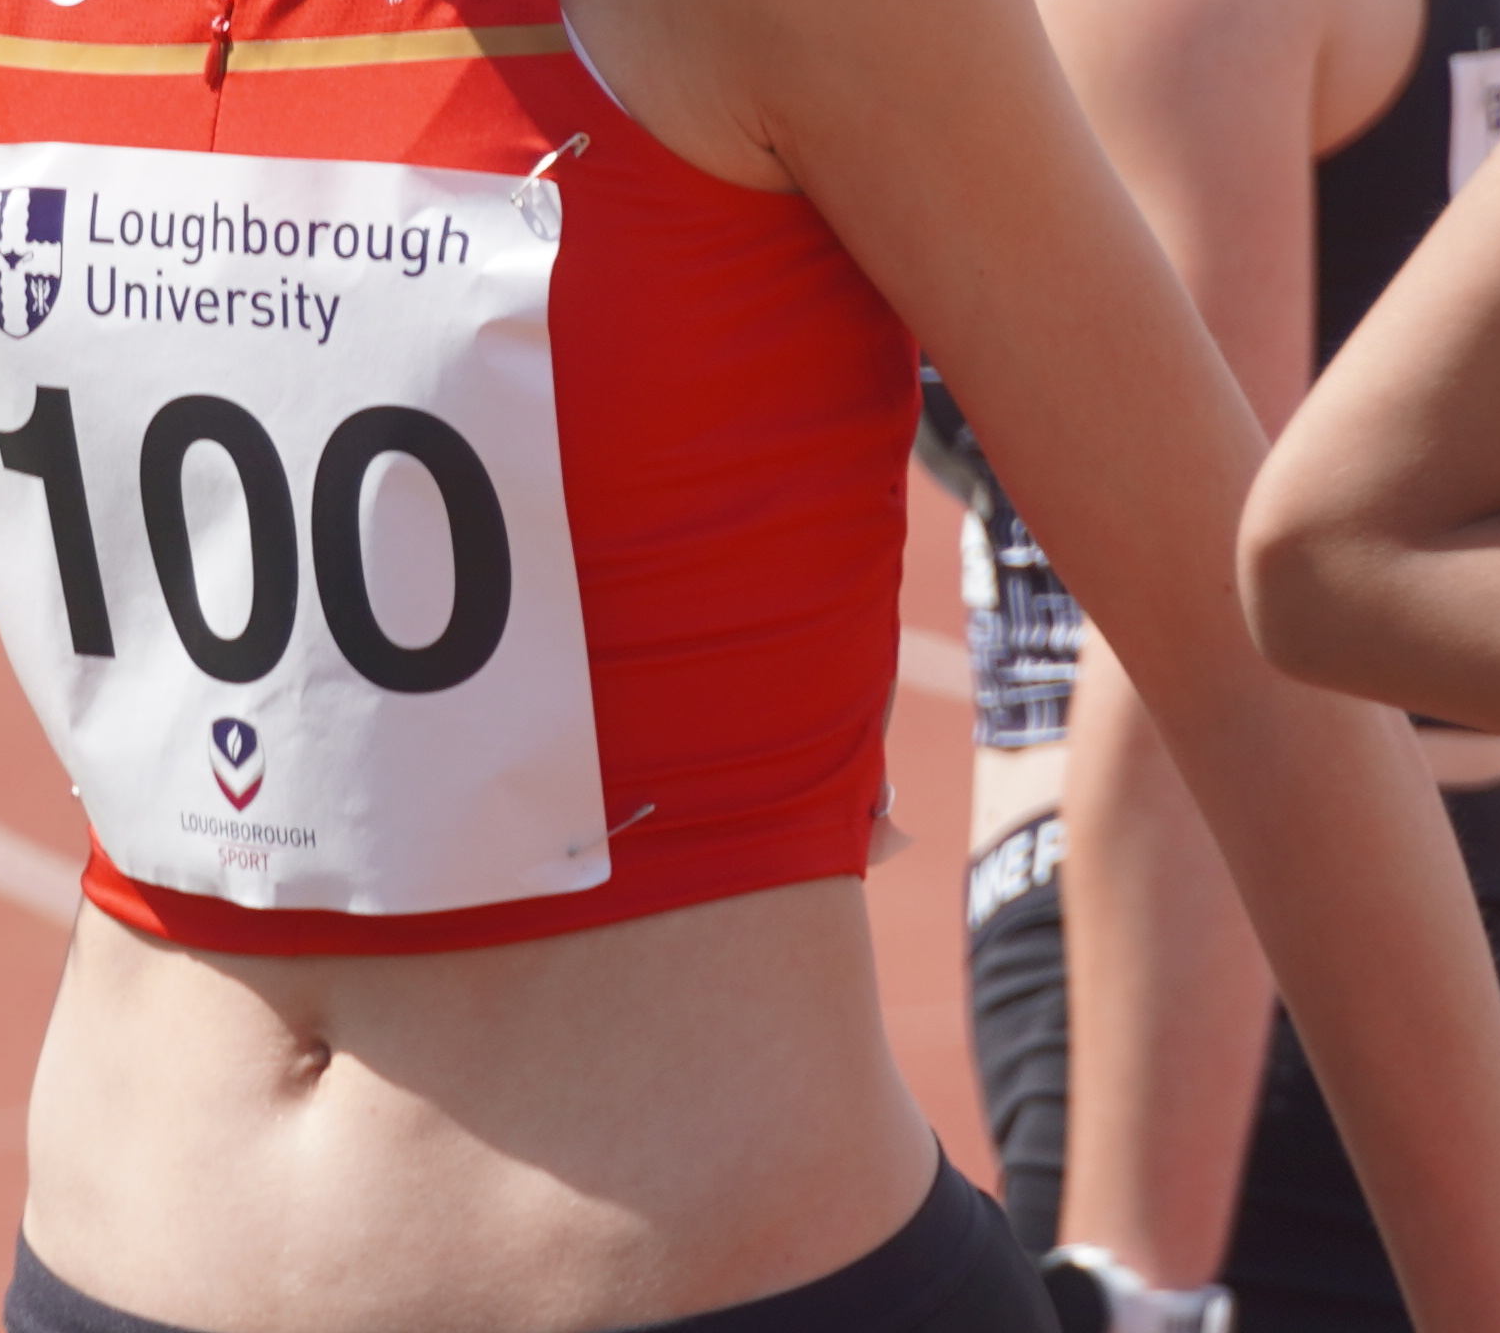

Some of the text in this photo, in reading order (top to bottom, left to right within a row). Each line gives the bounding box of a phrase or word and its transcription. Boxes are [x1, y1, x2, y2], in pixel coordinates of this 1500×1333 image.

[88, 192, 470, 277] Loughborough
[86, 264, 340, 344] University
[180, 811, 317, 848] LOUGHBOROUGH
[218, 846, 270, 872] SPORT
